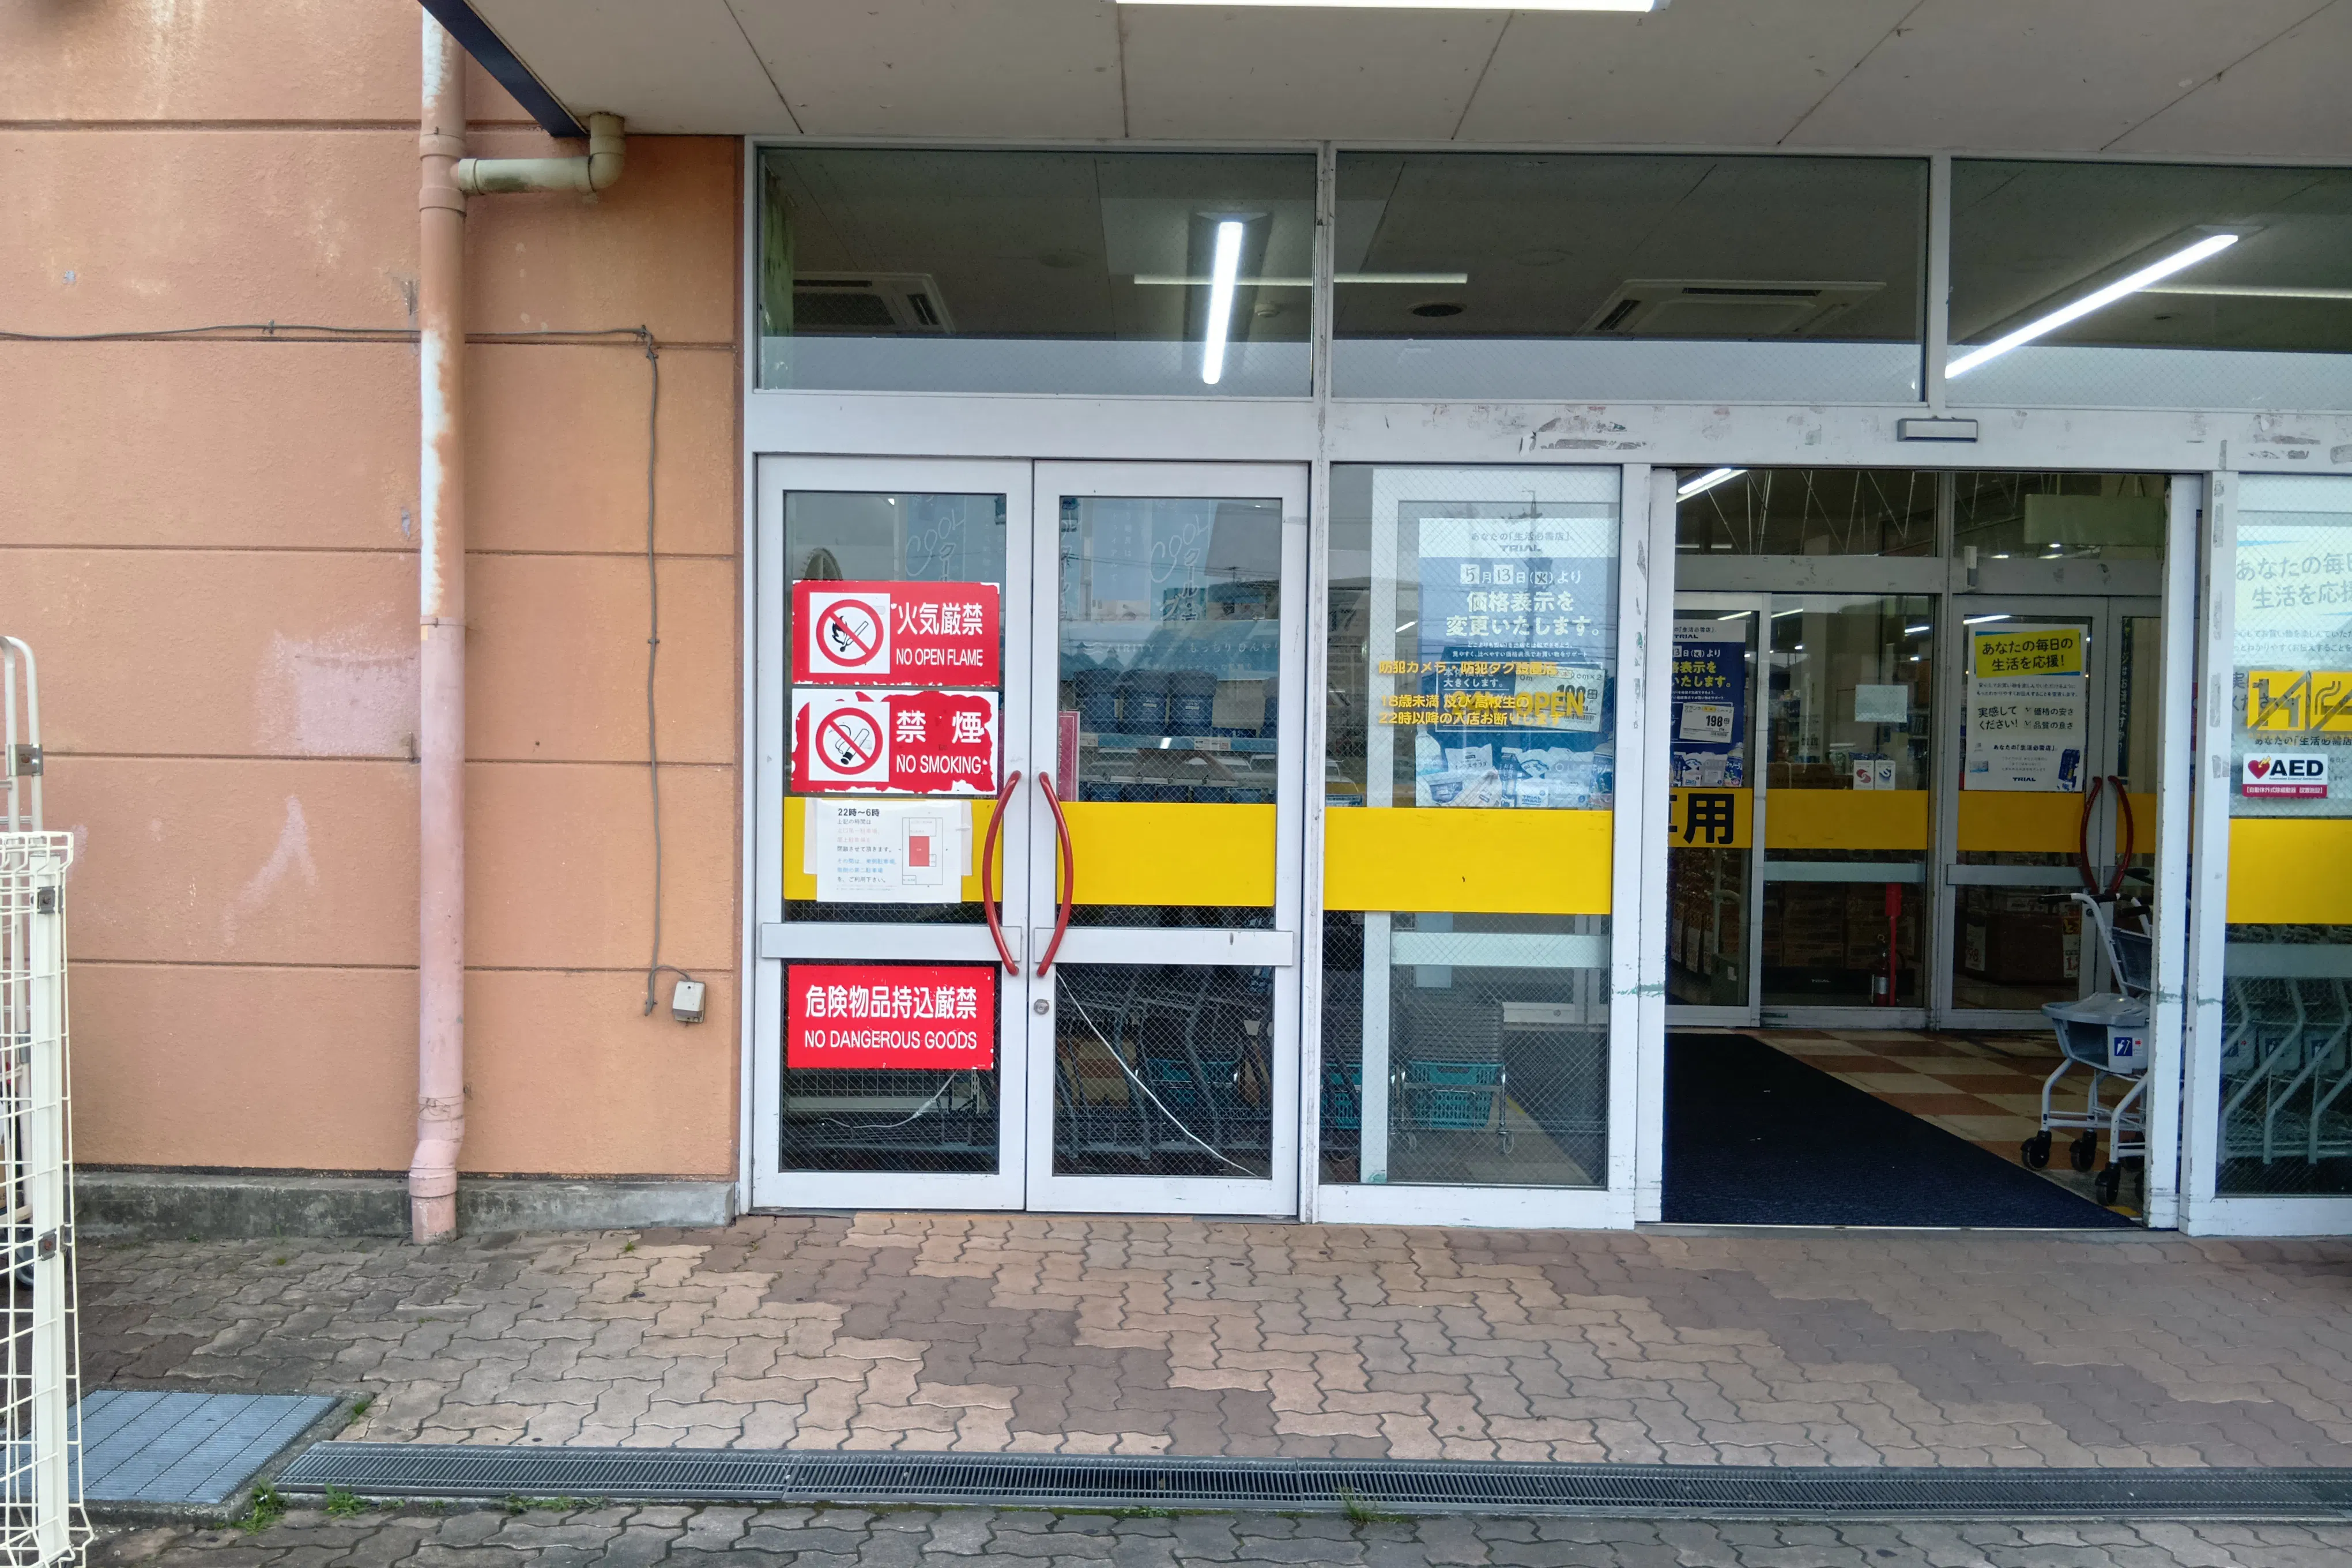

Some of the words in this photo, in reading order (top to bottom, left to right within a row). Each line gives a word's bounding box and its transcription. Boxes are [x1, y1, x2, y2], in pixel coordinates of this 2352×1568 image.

[1467, 591, 1574, 612] 価格表示を
[897, 602, 983, 636] 火気厳禁
[1446, 616, 1599, 636] 変更いたします。
[1982, 638, 2074, 655] あなたの毎日の
[896, 649, 913, 665] NO
[915, 649, 945, 666] OPEN
[947, 649, 983, 666] FLAME
[1992, 655, 2064, 672] 生活を応援!
[1378, 660, 1559, 676] 防犯カメラ・防犯タグ設置店
[1443, 677, 1504, 688] 大きくします。
[1381, 694, 1439, 709] 18歳未満
[1516, 691, 1584, 718] OPEN
[1378, 711, 1562, 726] 22時以降の入店お断りします
[1978, 706, 2017, 718] 実感して
[2033, 707, 2075, 717] 価格の安さ
[1706, 715, 1723, 727] 198
[1979, 719, 2018, 730] ください!
[2033, 721, 2074, 729] 品質の良さ
[896, 755, 917, 774] NO
[920, 755, 982, 774] SMOKING
[2270, 759, 2324, 777] AED
[805, 984, 977, 1020] 危険物品持込厳禁
[805, 1030, 826, 1048] NO
[830, 1030, 921, 1049] DANGEROUS
[924, 1030, 978, 1050] GOODS
